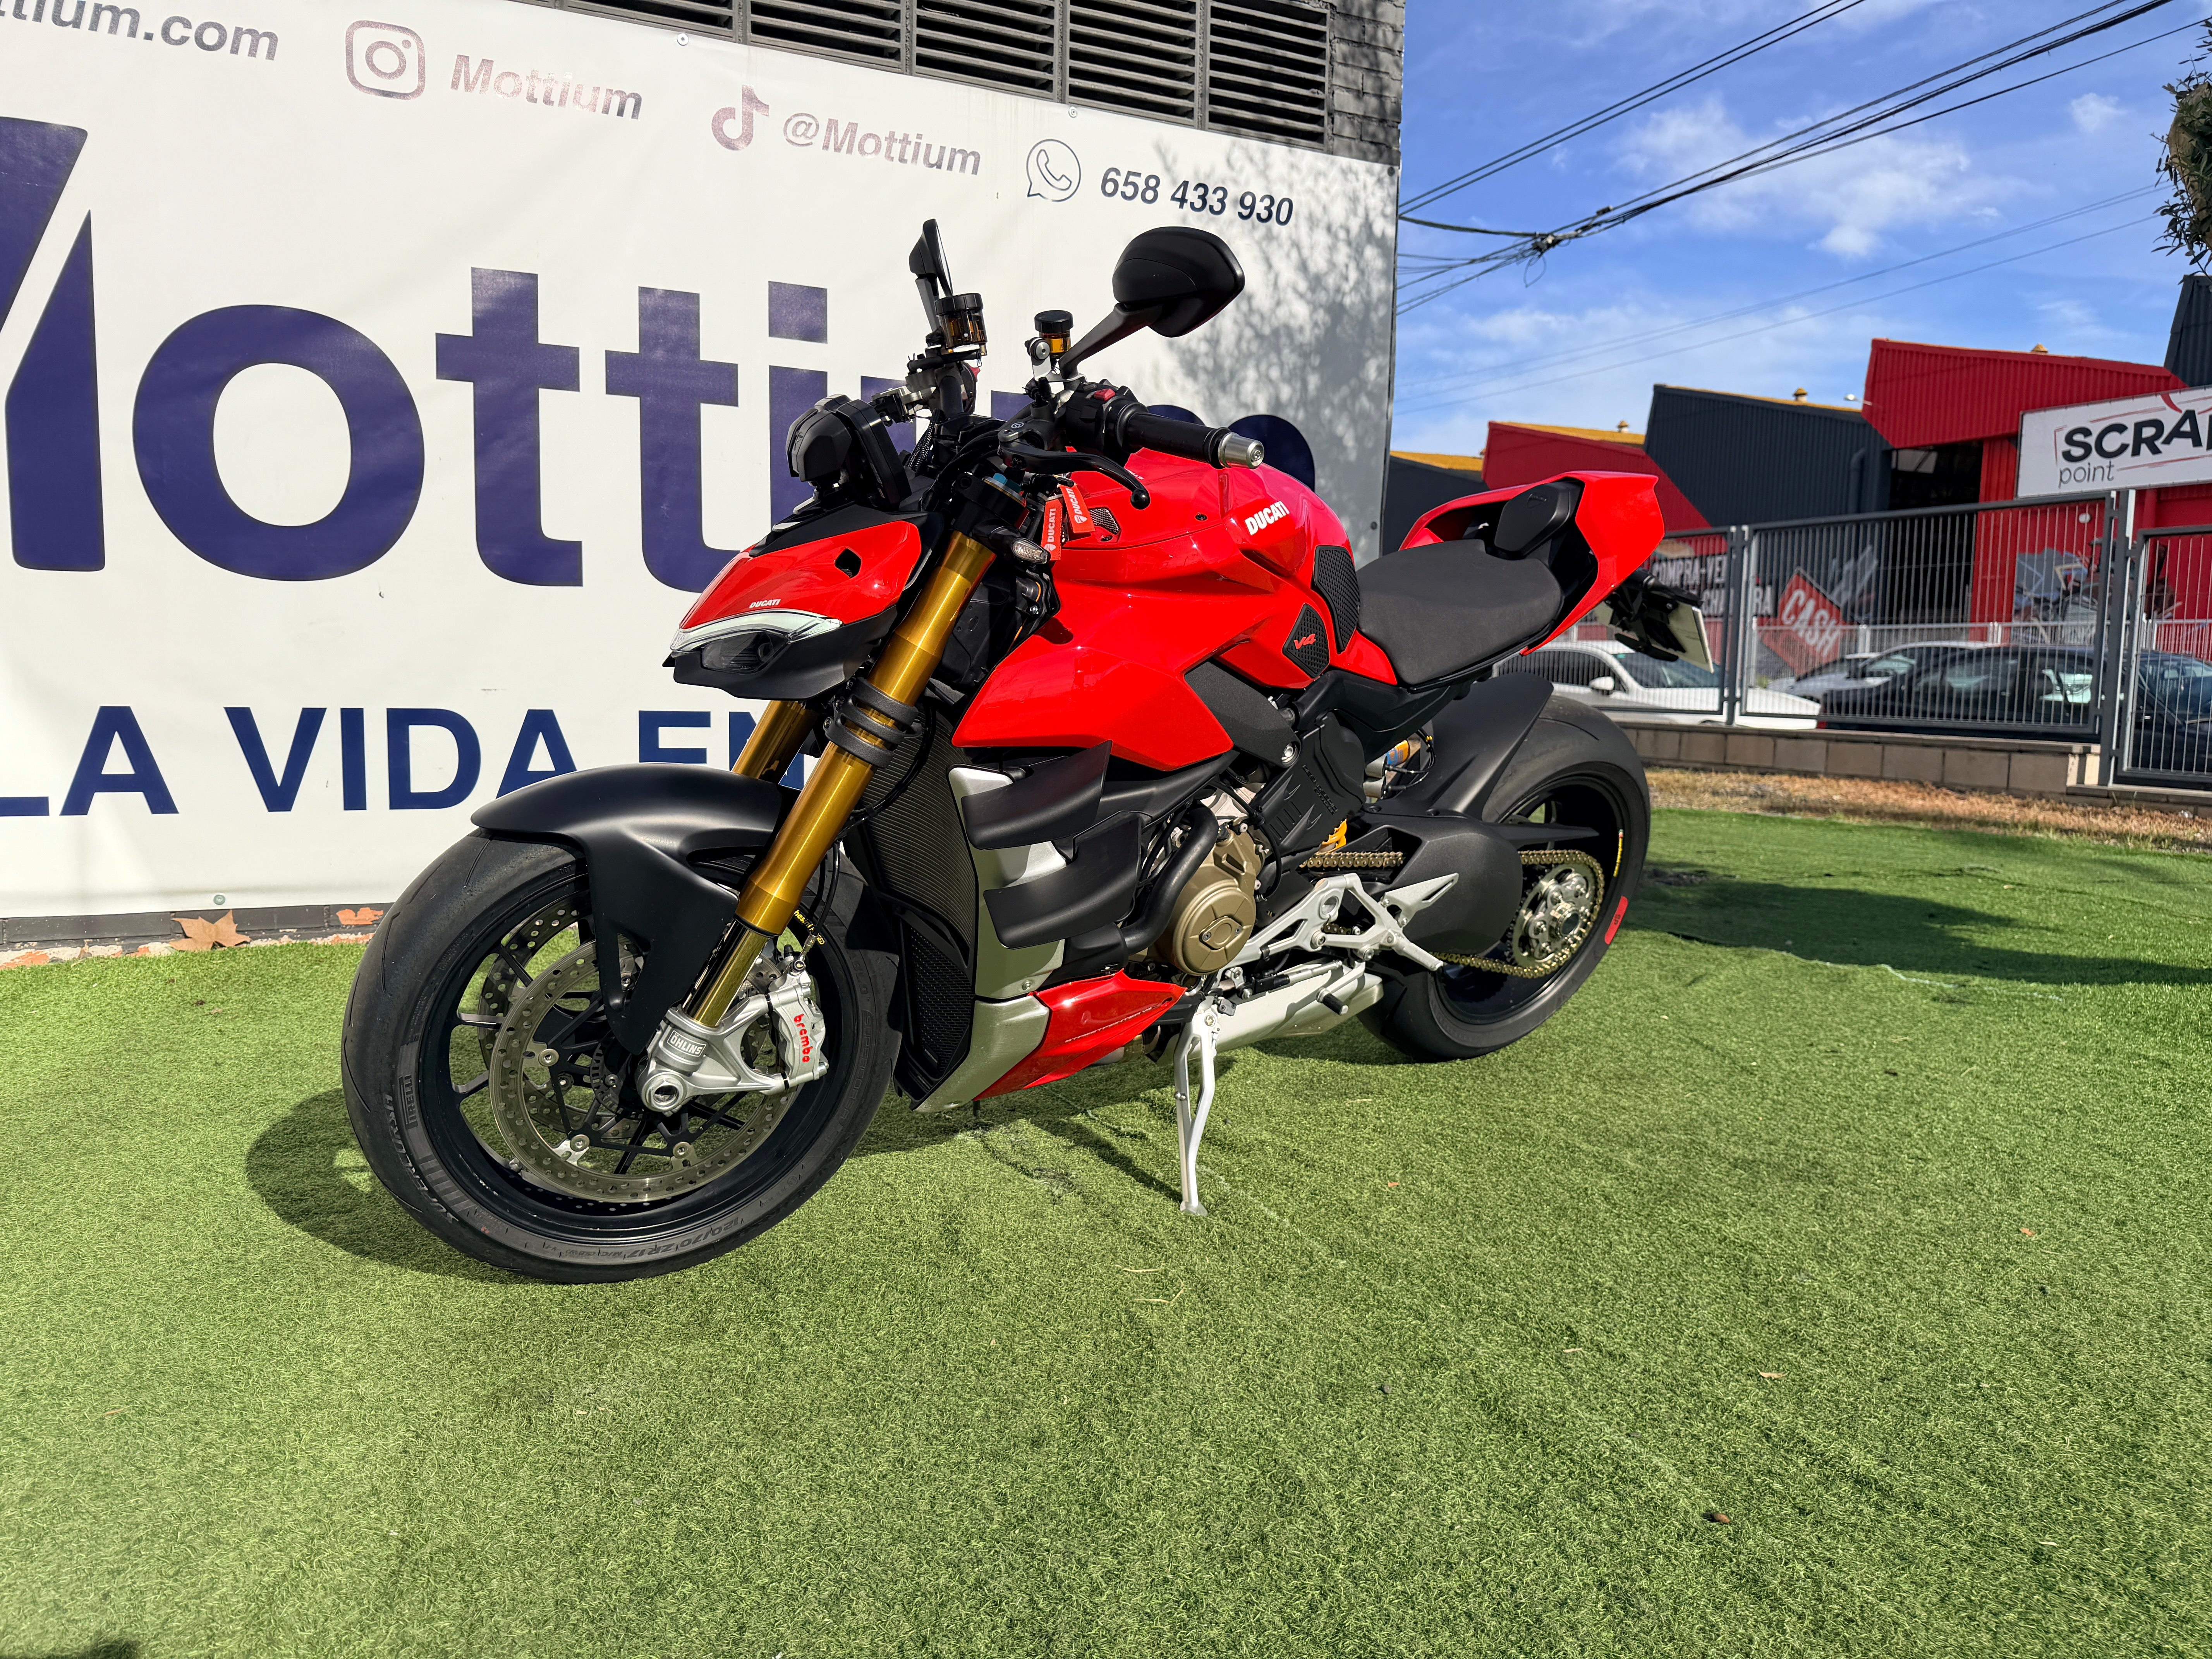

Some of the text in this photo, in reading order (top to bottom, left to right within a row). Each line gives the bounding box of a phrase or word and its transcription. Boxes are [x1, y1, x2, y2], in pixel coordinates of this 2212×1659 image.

[0, 0, 278, 60] tium.com
[450, 54, 643, 120] Mottium
[783, 112, 981, 176] @Mottium
[1101, 167, 1294, 227] 658 433 930
[2062, 409, 2212, 462] SCRA
[2058, 461, 2115, 488] point
[1065, 488, 1083, 515] DUCATI
[1245, 500, 1290, 536] DUCATI
[1047, 508, 1056, 542] DUCATI
[1652, 555, 1728, 586] COMPRA-VE
[749, 599, 781, 609] DUCATI
[1782, 588, 1841, 658] CASH
[1294, 633, 1316, 649] V4
[223, 707, 582, 812] VIDA
[670, 1033, 704, 1054] ÖHLINS
[793, 1013, 814, 1063] brembo
[839, 1015, 871, 1120] SUPERCORSA
[398, 1074, 419, 1130] PIRELLI
[627, 1243, 674, 1258] ZR17
[680, 1217, 739, 1248] 120/70
